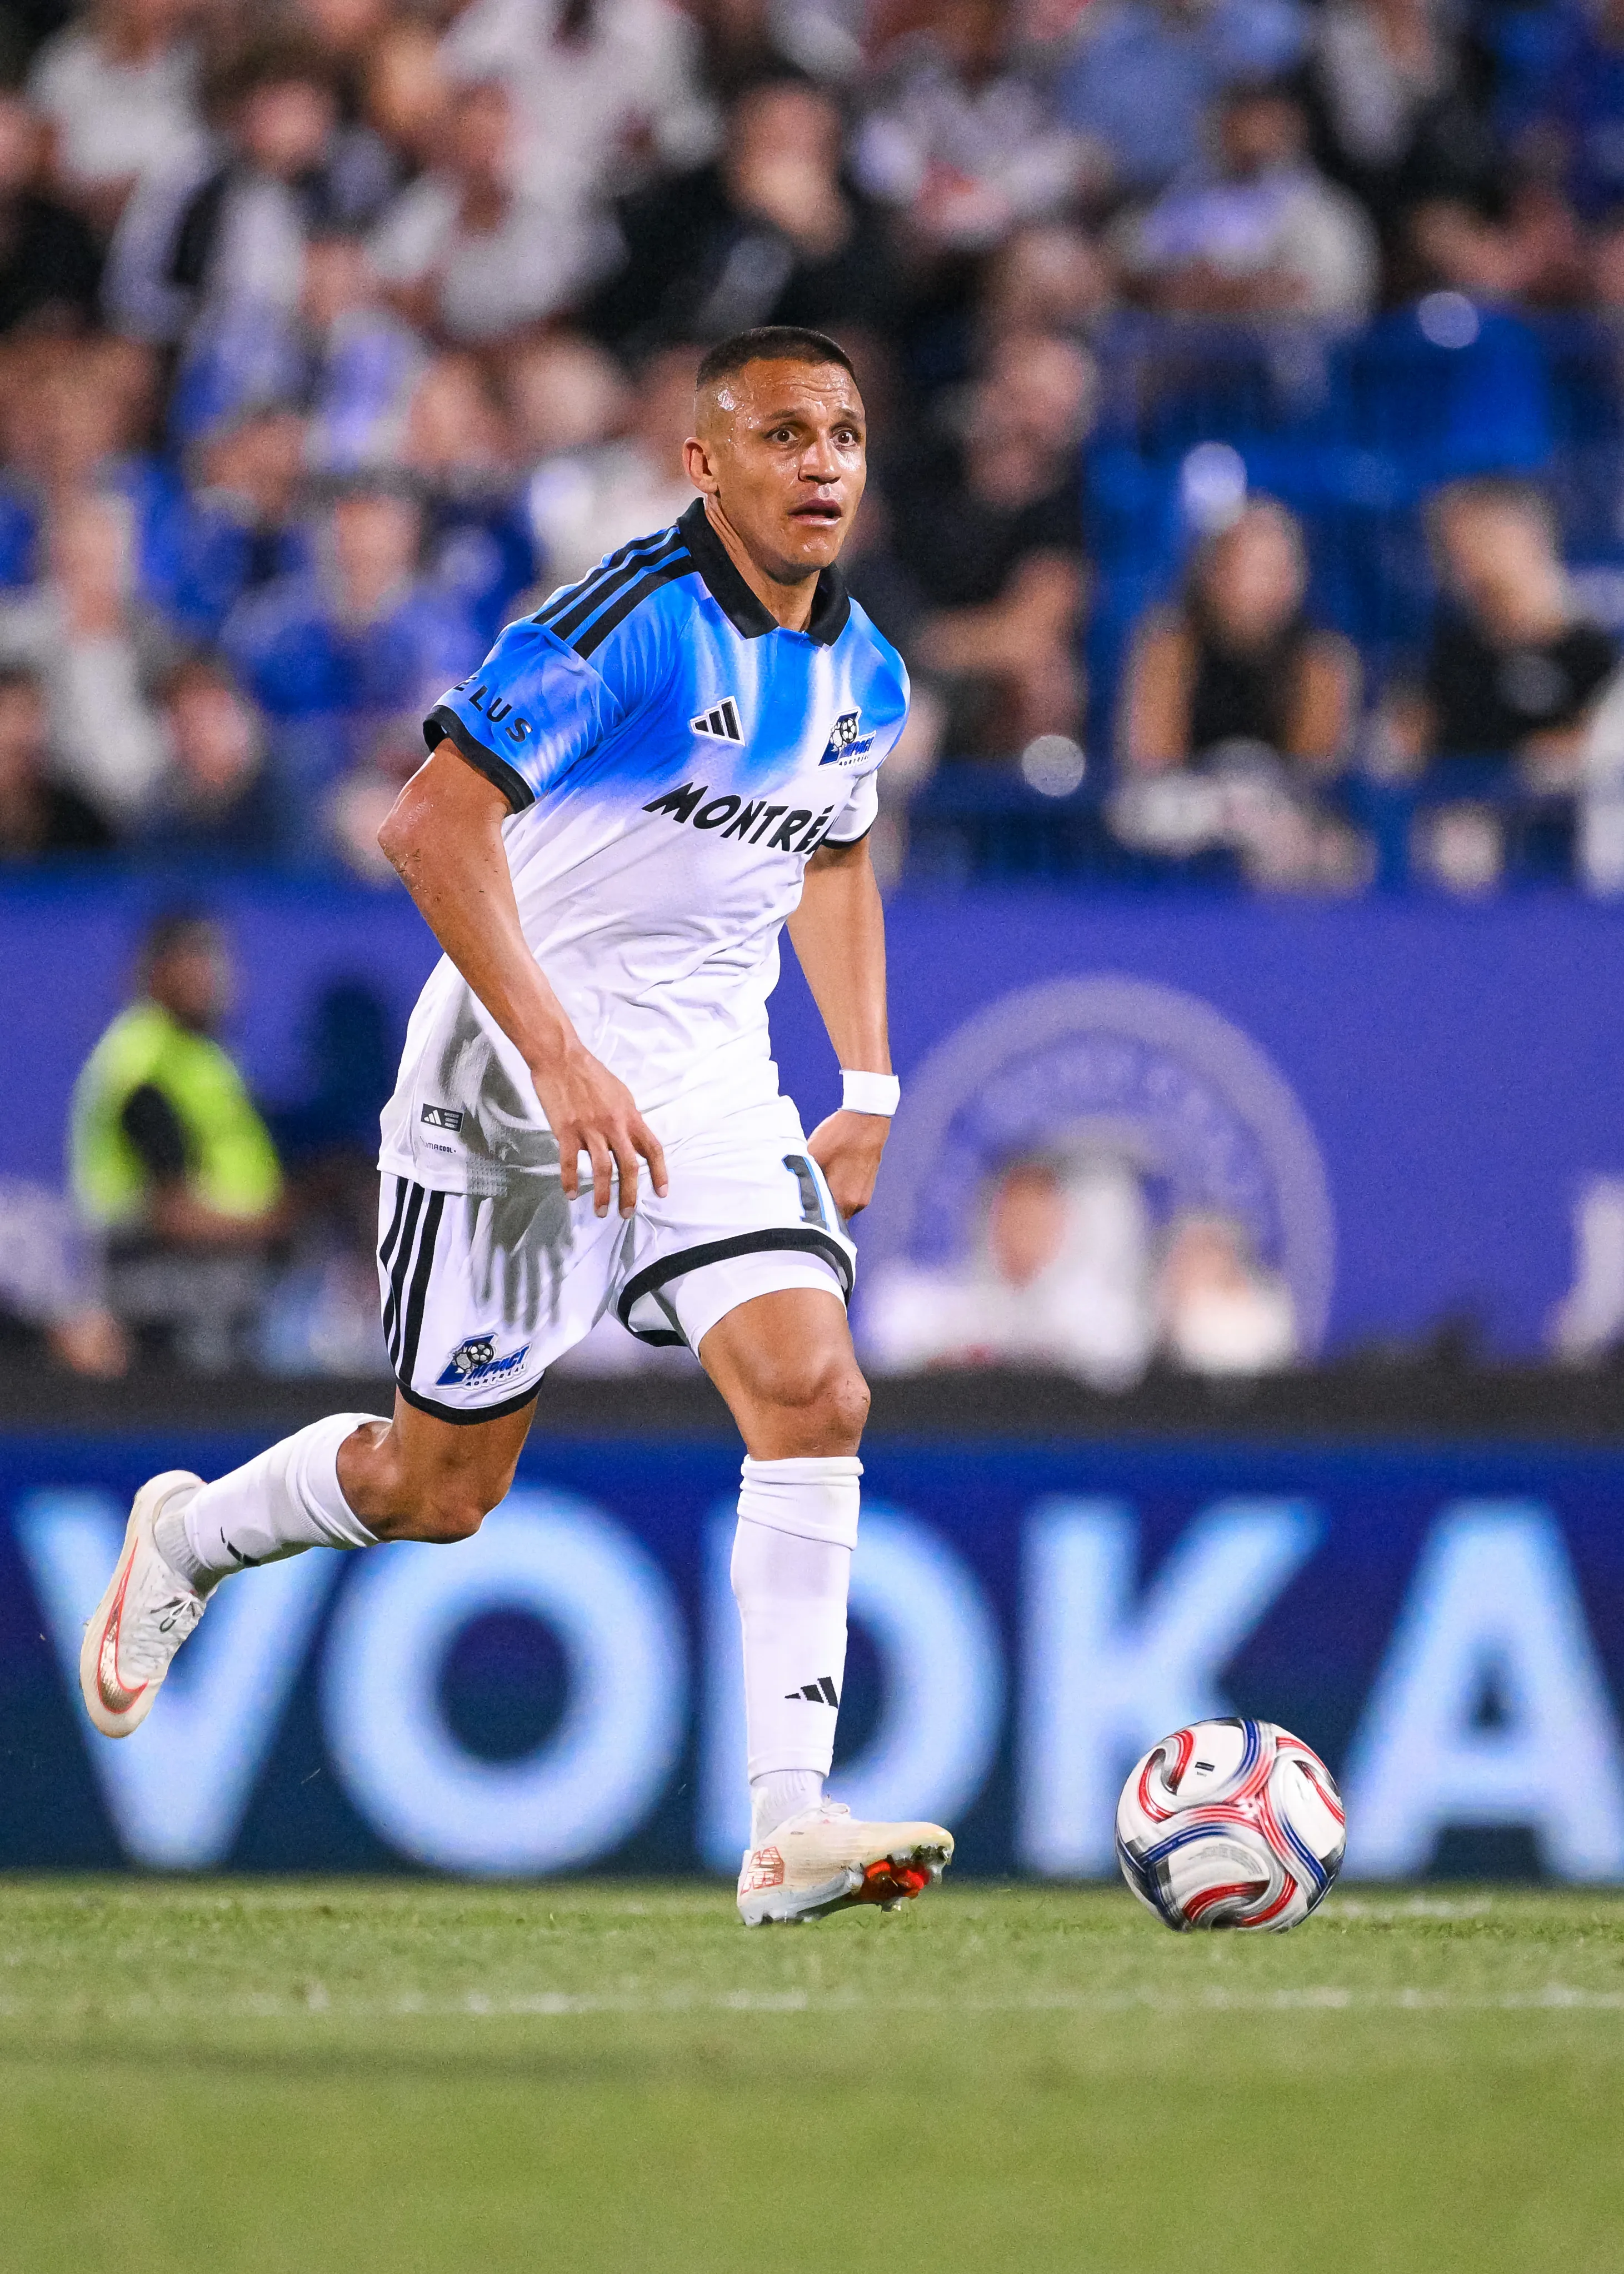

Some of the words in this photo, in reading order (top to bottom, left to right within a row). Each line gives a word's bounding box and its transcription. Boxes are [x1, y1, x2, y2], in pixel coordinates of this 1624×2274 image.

[452, 676, 534, 743] ELUS
[641, 781, 836, 855] MONTRÉ
[781, 1154, 846, 1236] 1
[14, 1489, 1624, 1878] VODKA
